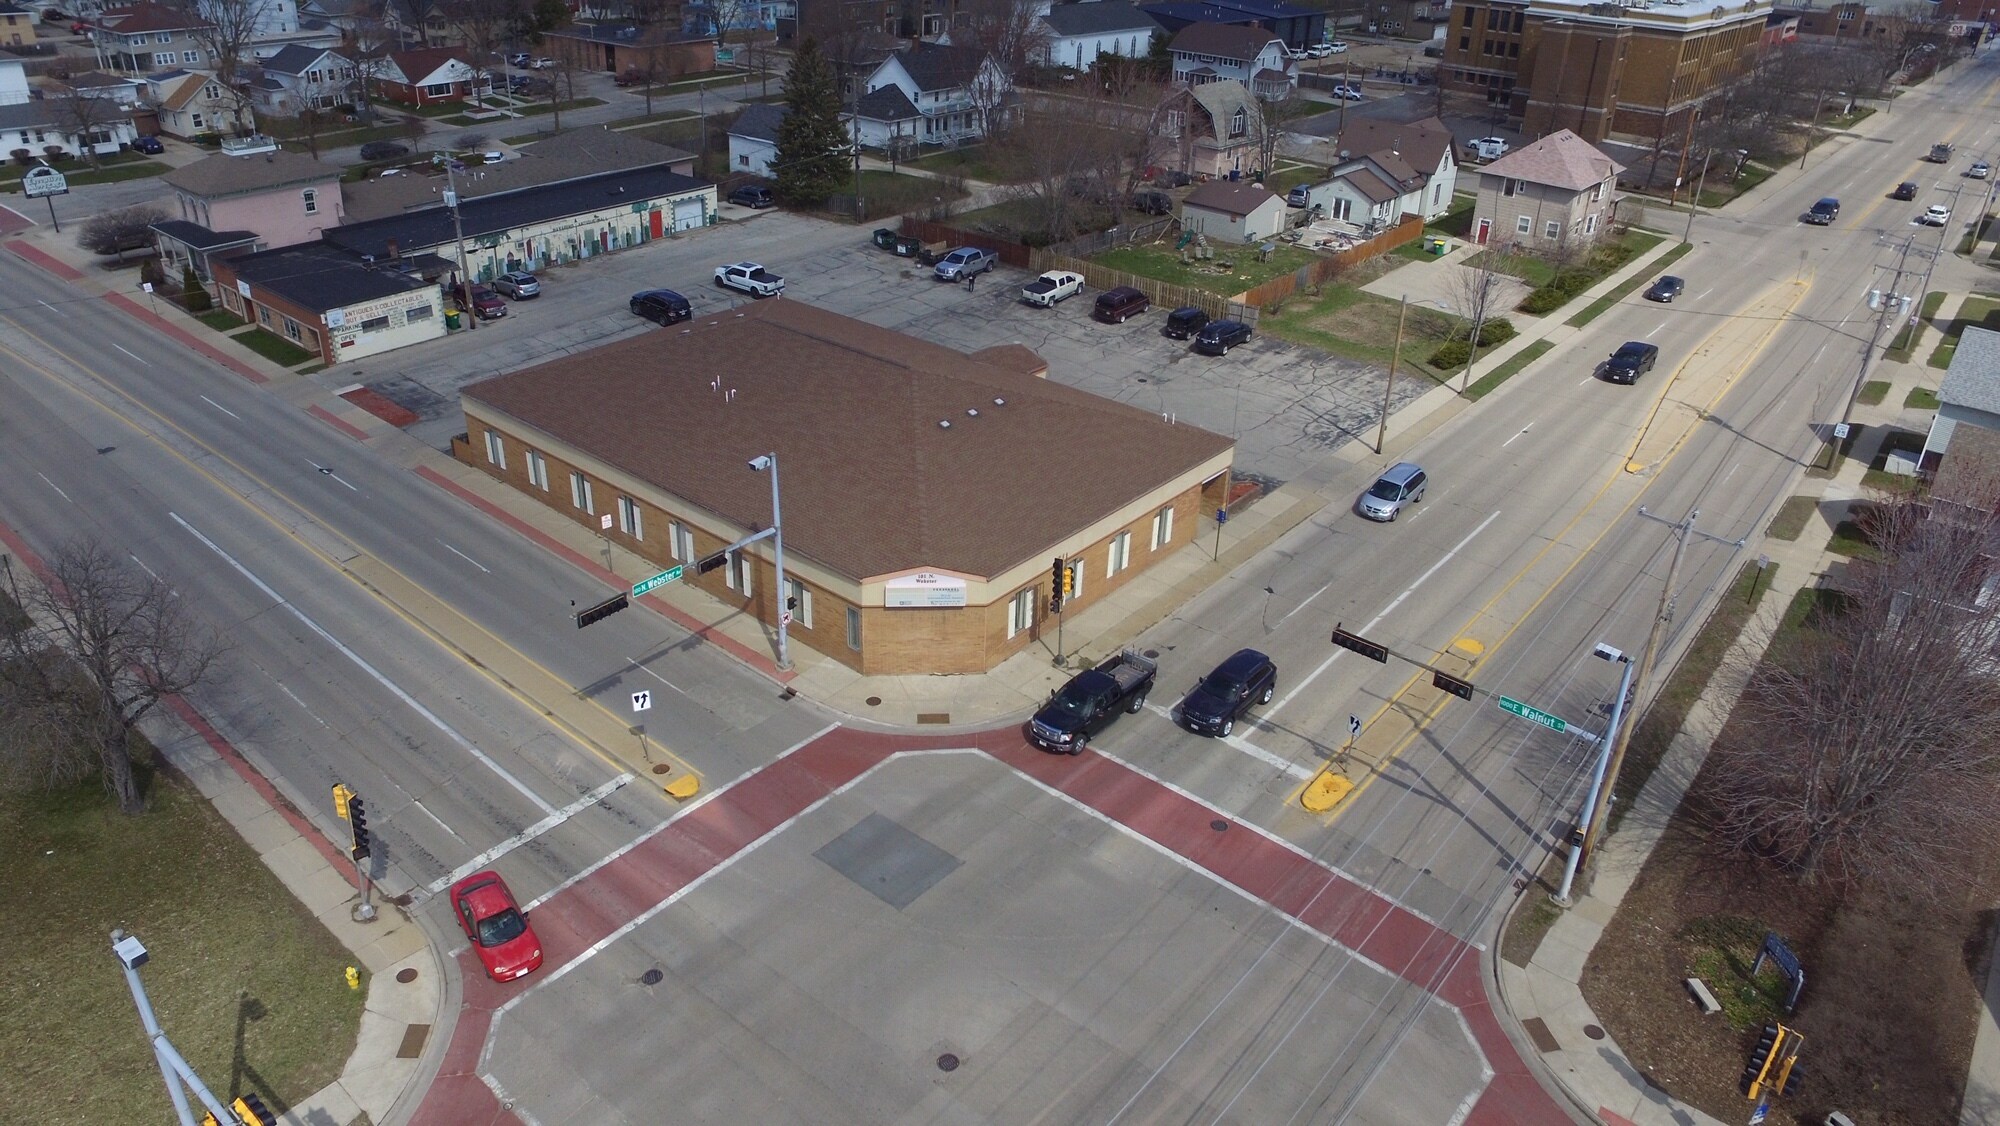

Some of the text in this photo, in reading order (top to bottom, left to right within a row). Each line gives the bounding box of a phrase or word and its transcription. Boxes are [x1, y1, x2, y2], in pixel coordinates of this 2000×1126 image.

[344, 305, 374, 318] ANTIQUES
[379, 294, 424, 310] COLLECTABLES
[345, 314, 358, 325] BUY
[366, 310, 381, 319] SELL
[340, 333, 357, 342] OPEN
[648, 571, 675, 589] Webster
[1513, 704, 1520, 713] E.
[1521, 706, 1556, 728] Walnut
